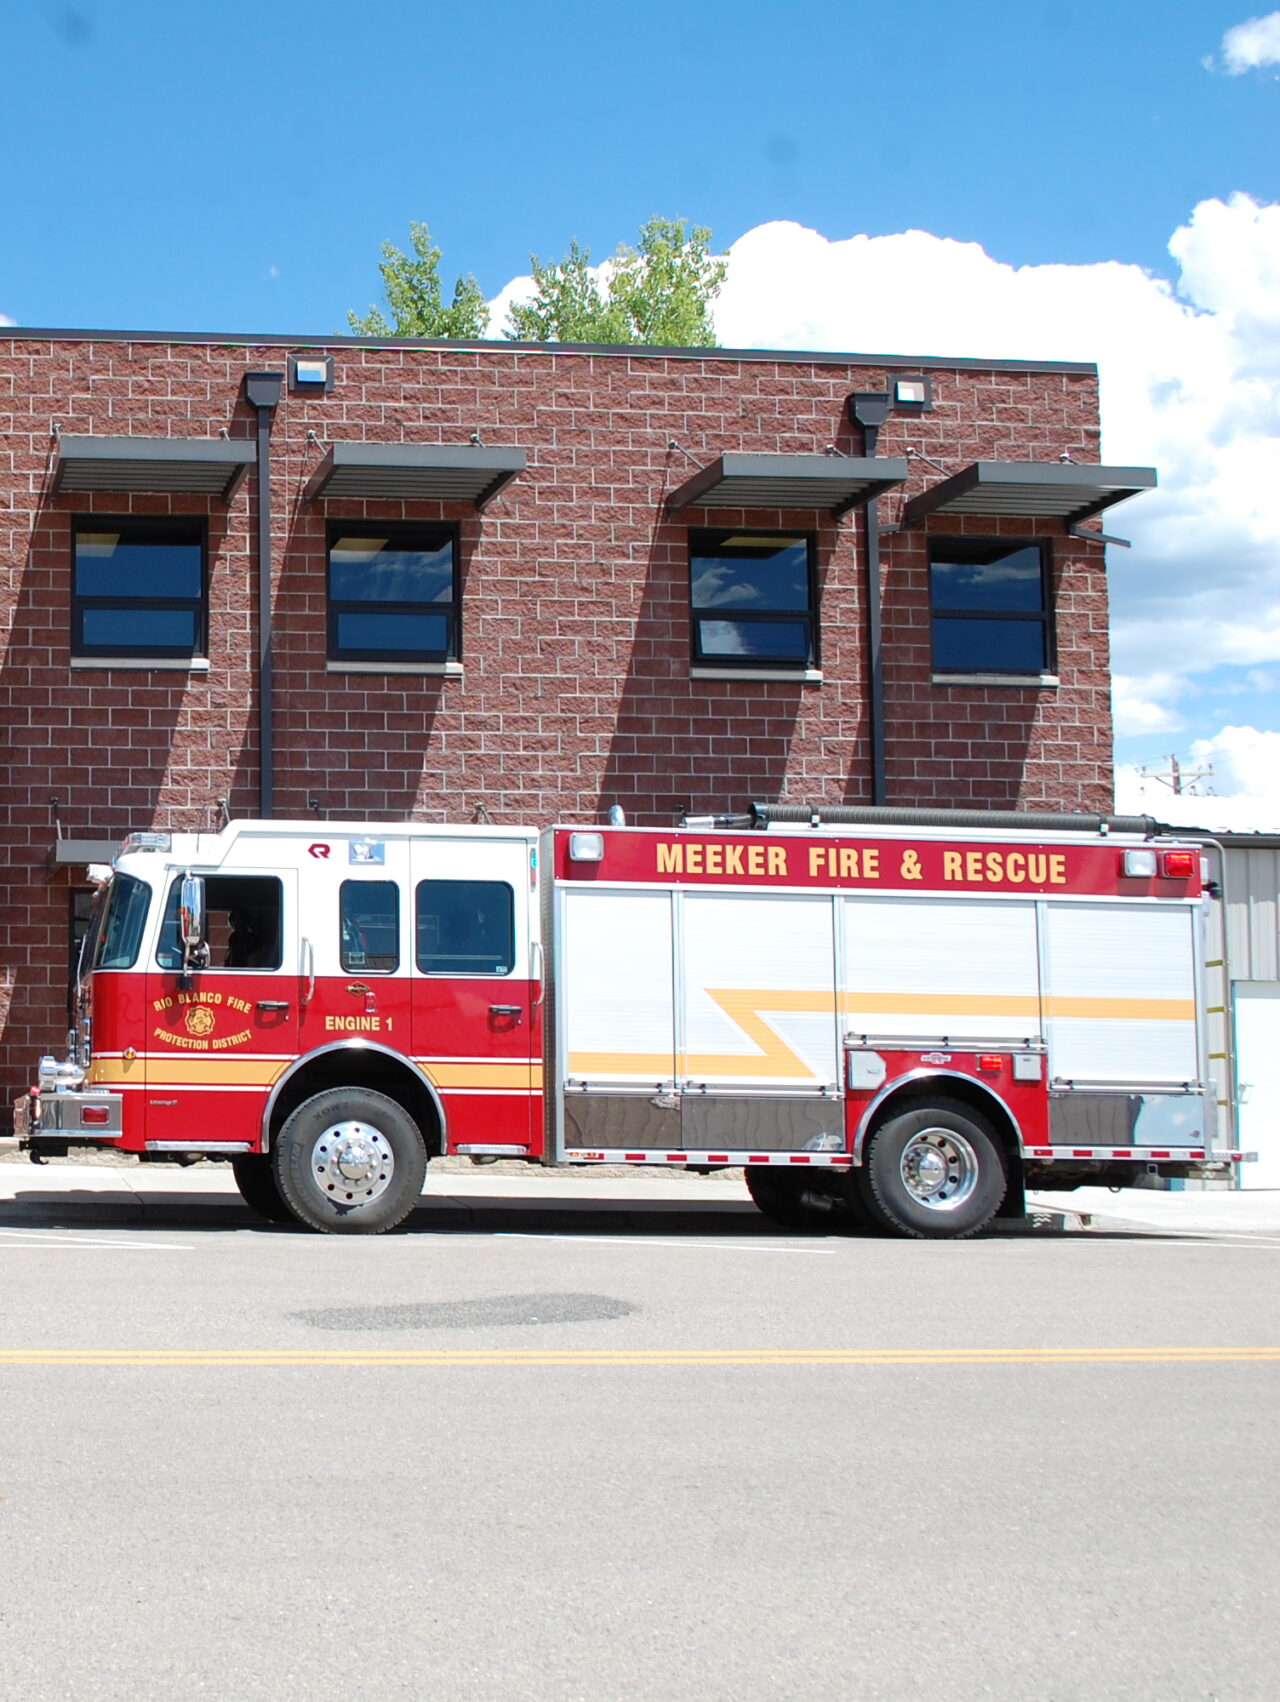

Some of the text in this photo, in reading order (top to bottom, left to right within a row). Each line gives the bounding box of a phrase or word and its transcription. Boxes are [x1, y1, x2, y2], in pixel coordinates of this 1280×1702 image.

[656, 843, 1068, 885] MEEKER FIRE & RESCUE
[153, 991, 253, 1014] RIO BLANCO FIRE
[325, 1015, 393, 1031] ENGINE 1
[153, 1027, 253, 1050] PROTECTION DISTRICT
